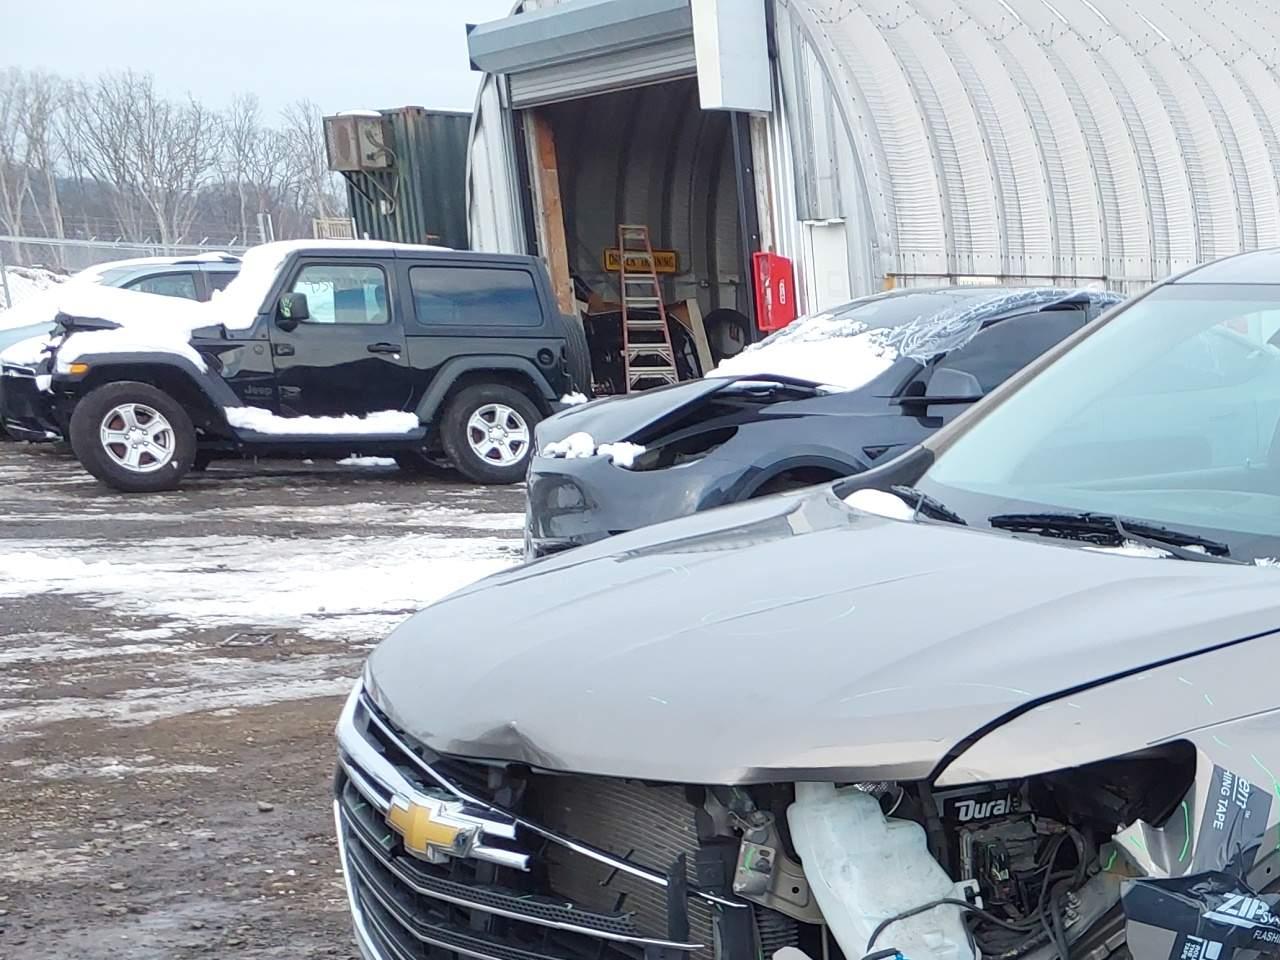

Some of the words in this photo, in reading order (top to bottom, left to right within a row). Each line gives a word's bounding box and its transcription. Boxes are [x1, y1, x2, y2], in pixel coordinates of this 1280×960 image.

[1213, 798, 1228, 831] TAPE
[1215, 892, 1270, 919] ZIP
[1180, 942, 1191, 960] TAPE
